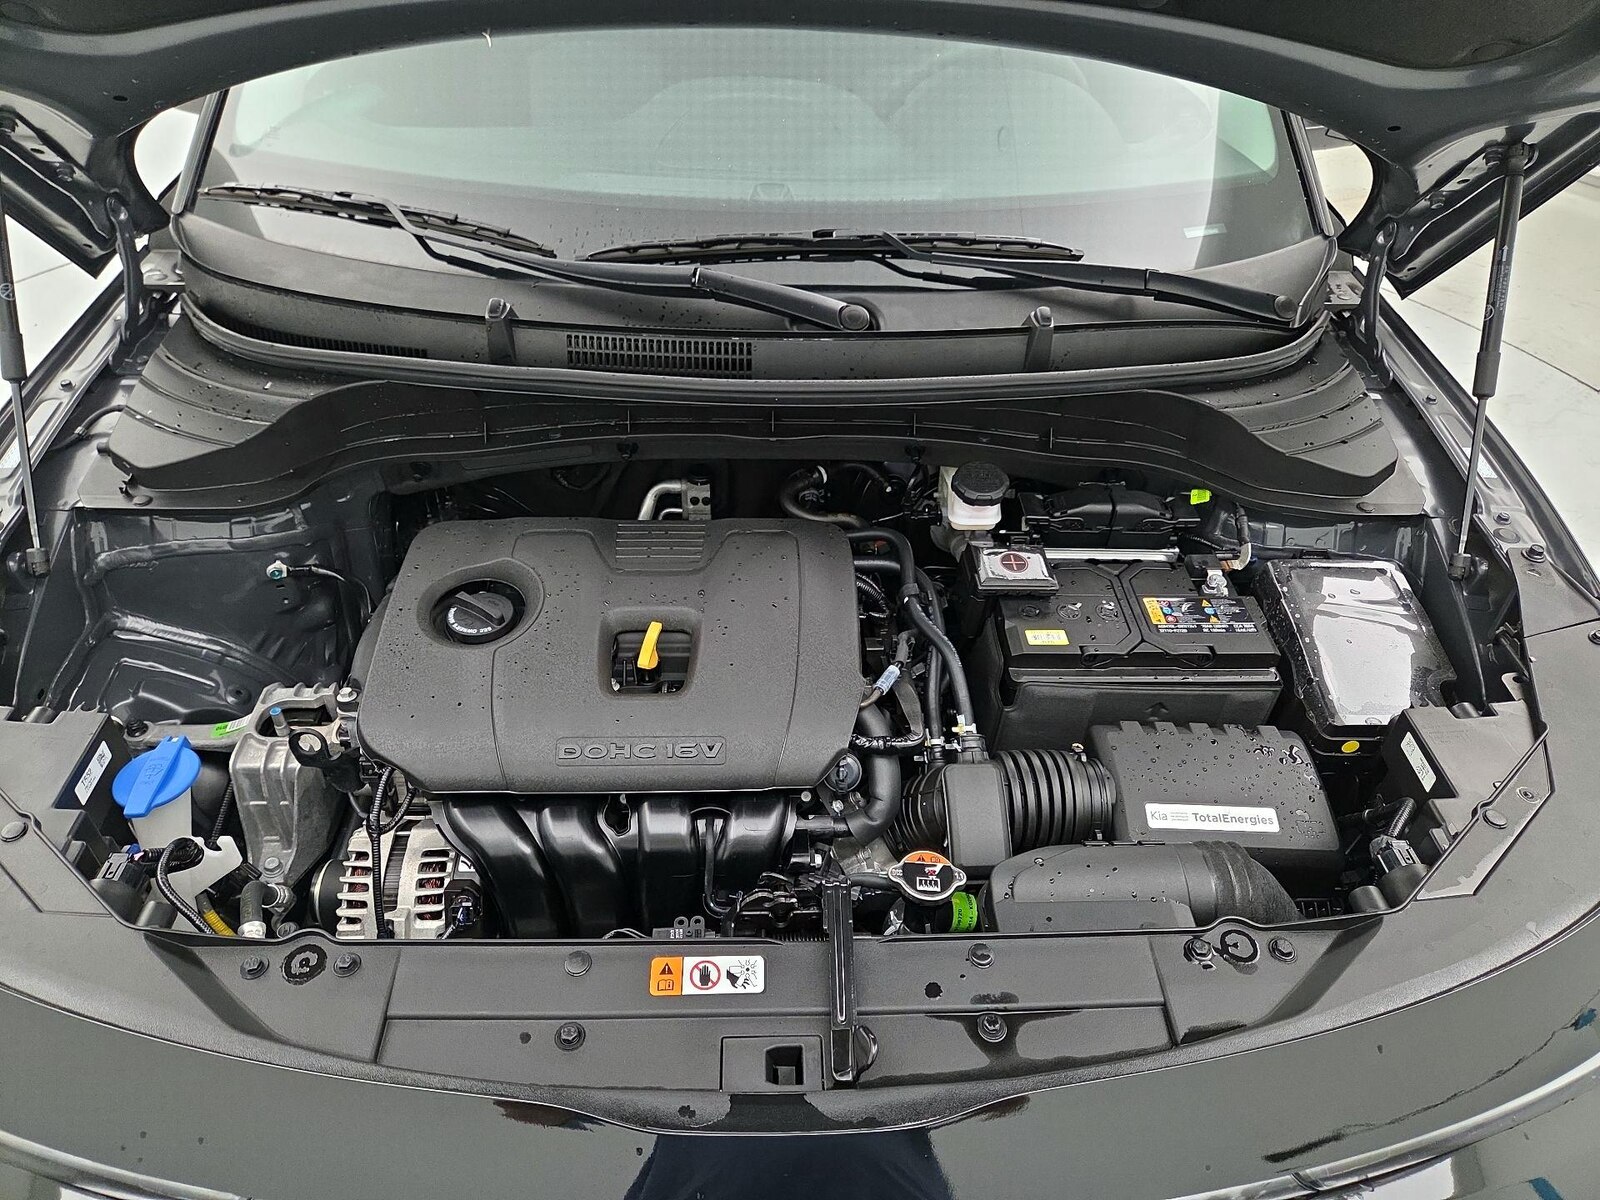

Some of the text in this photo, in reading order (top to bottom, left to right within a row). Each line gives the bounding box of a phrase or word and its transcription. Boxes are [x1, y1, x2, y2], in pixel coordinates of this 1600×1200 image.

[558, 742, 723, 760] DOHC 16V
[1150, 811, 1168, 821] Kia
[1192, 812, 1274, 826] TotalEnergies
